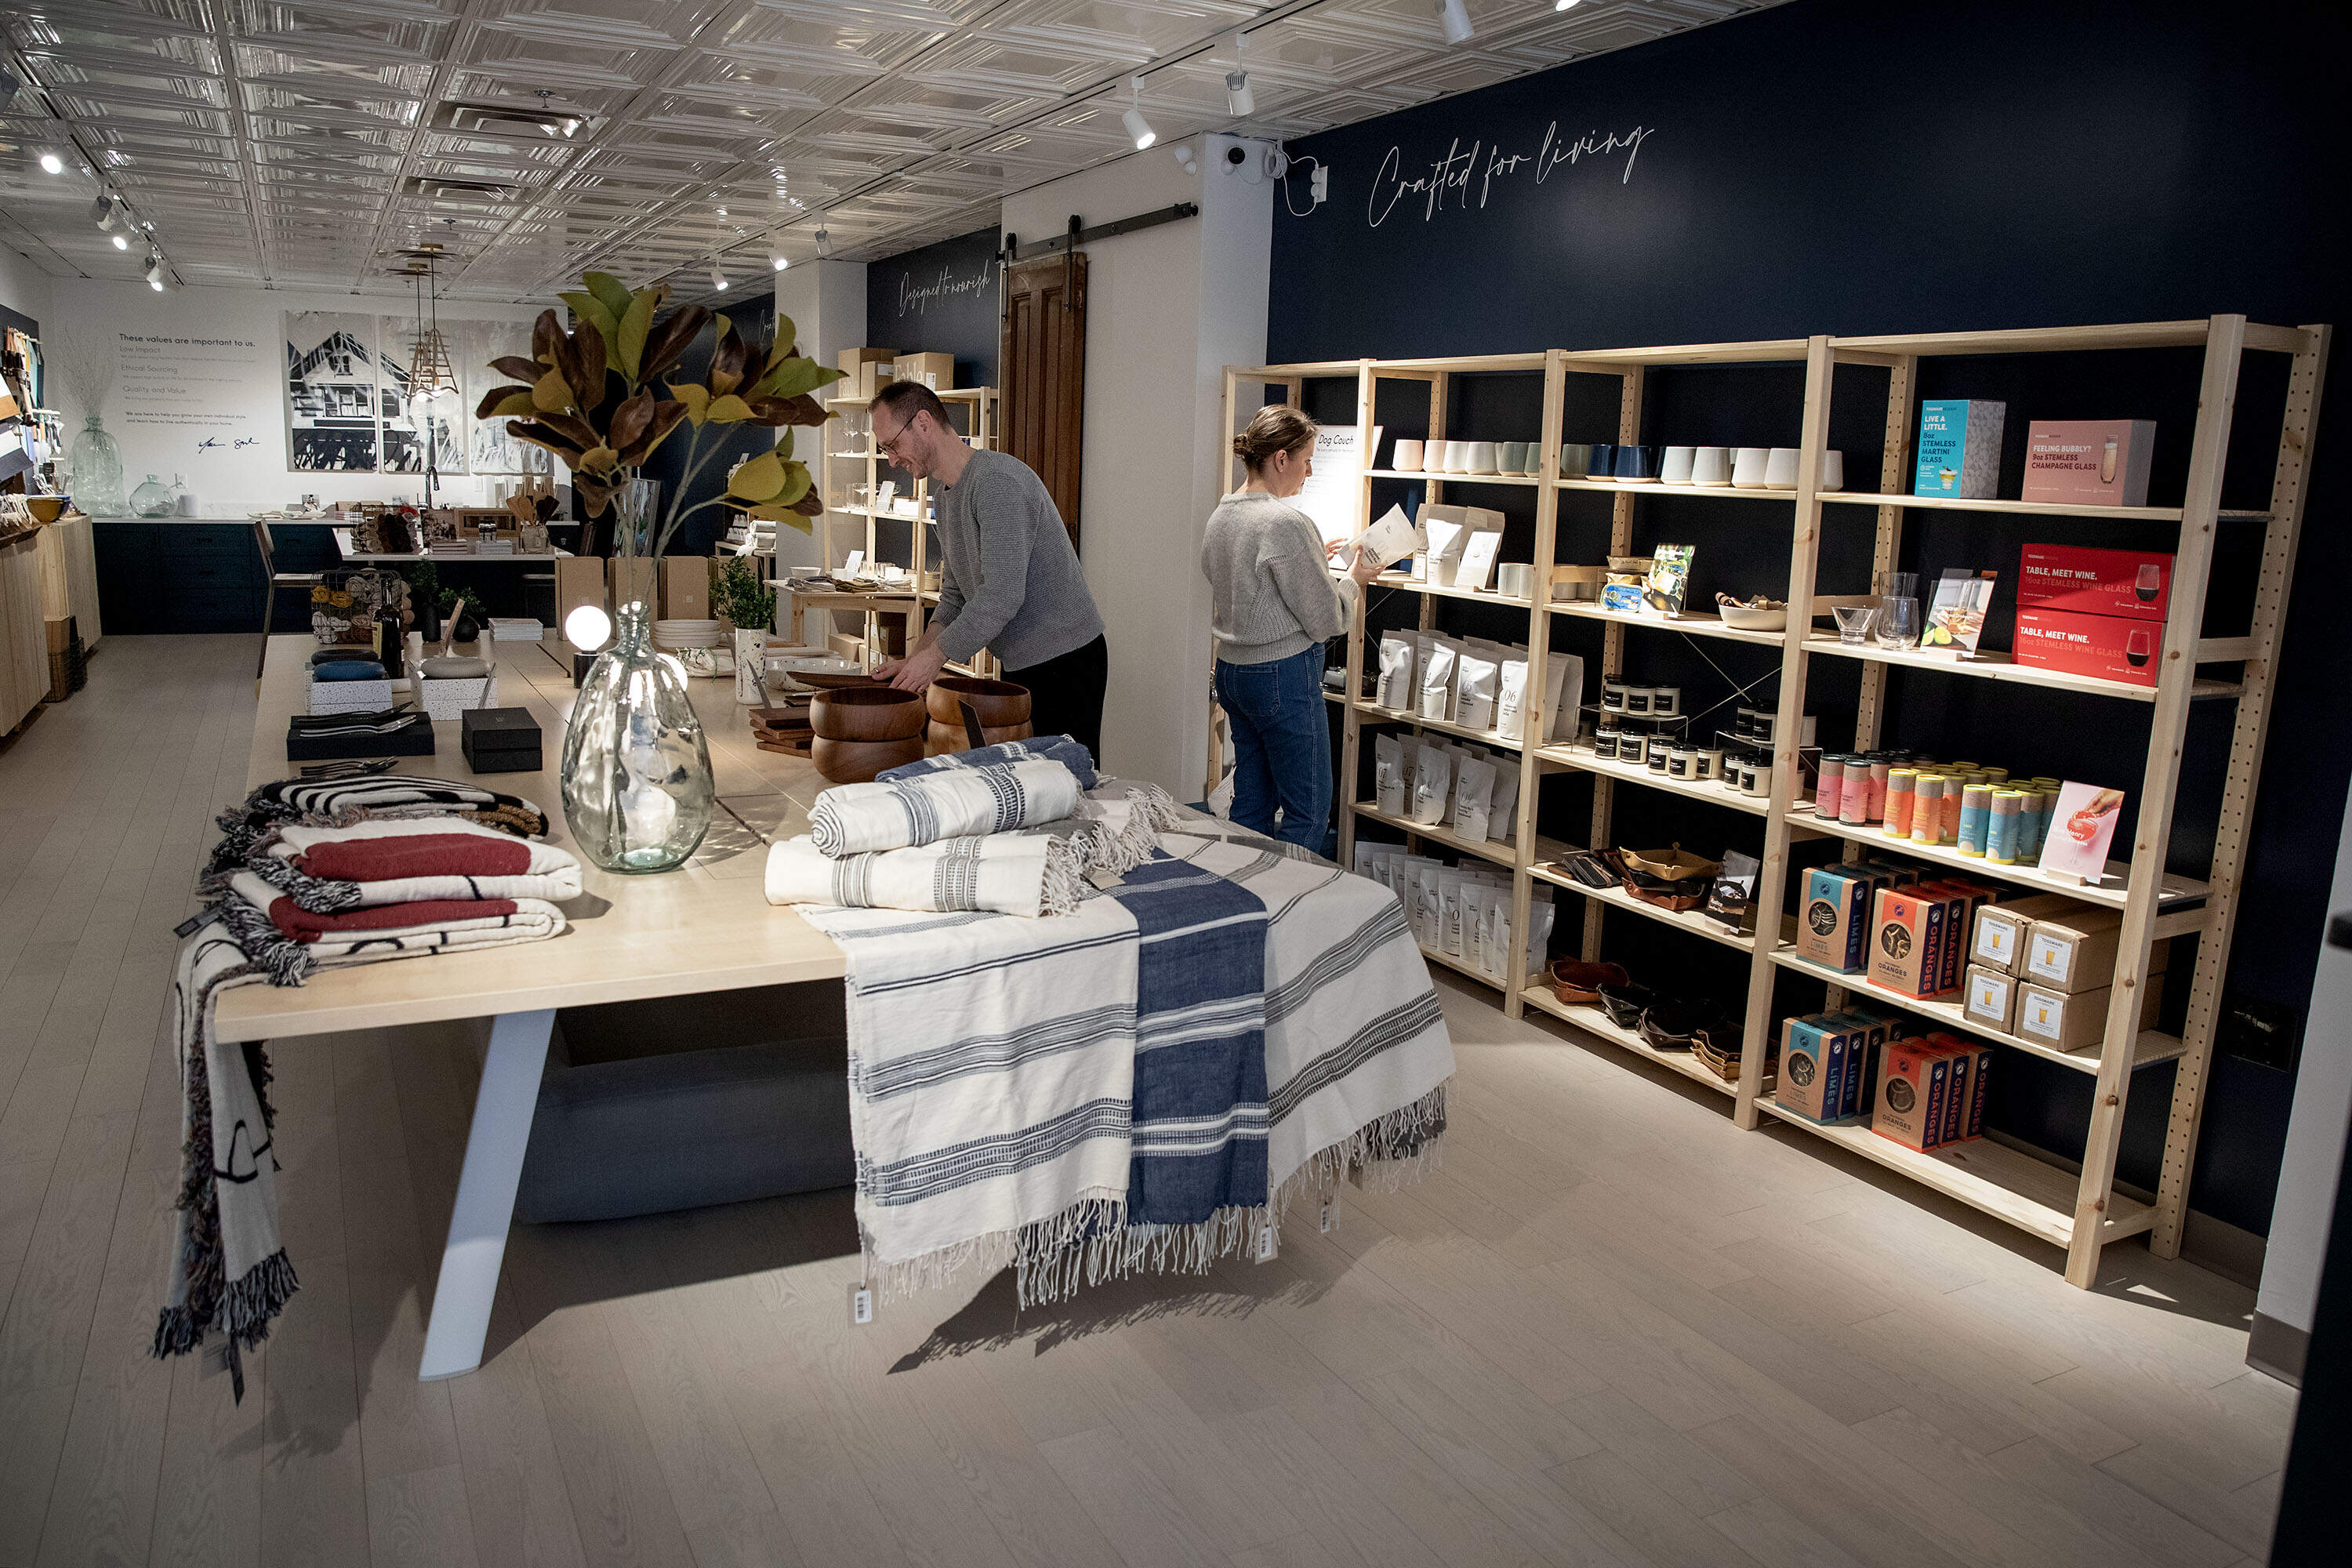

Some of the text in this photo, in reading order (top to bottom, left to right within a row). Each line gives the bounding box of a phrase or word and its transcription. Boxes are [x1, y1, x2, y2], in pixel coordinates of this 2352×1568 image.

[1368, 121, 1655, 227] Crafted for living
[119, 333, 143, 342] These
[192, 338, 232, 347] important
[147, 365, 178, 374] Sourcing
[122, 385, 150, 394] Quality
[1318, 434, 1354, 447] Dog Couch
[2026, 565, 2098, 580] TABLE, MEET WINE.
[2025, 576, 2131, 593] 16oz STEMLESS WINE GLASS
[2020, 626, 2089, 644] TABLE, MEET WINE.
[2020, 637, 2123, 659] 16oz STEMLESS WINE GLASS
[1504, 690, 1517, 702] 06
[1850, 915, 1860, 953] LIMES
[1923, 926, 1938, 990] ORANGES
[1944, 921, 1958, 985] ORANGES
[1878, 963, 1907, 977] ORANGES
[1827, 1068, 1838, 1105] LIMES
[1846, 1063, 1857, 1100] LIMES
[1927, 1082, 1941, 1144] ORANGES
[1947, 1078, 1962, 1138] ORANGES
[1973, 1073, 1987, 1133] ORANGES
[1882, 1114, 1911, 1131] ORANGES
